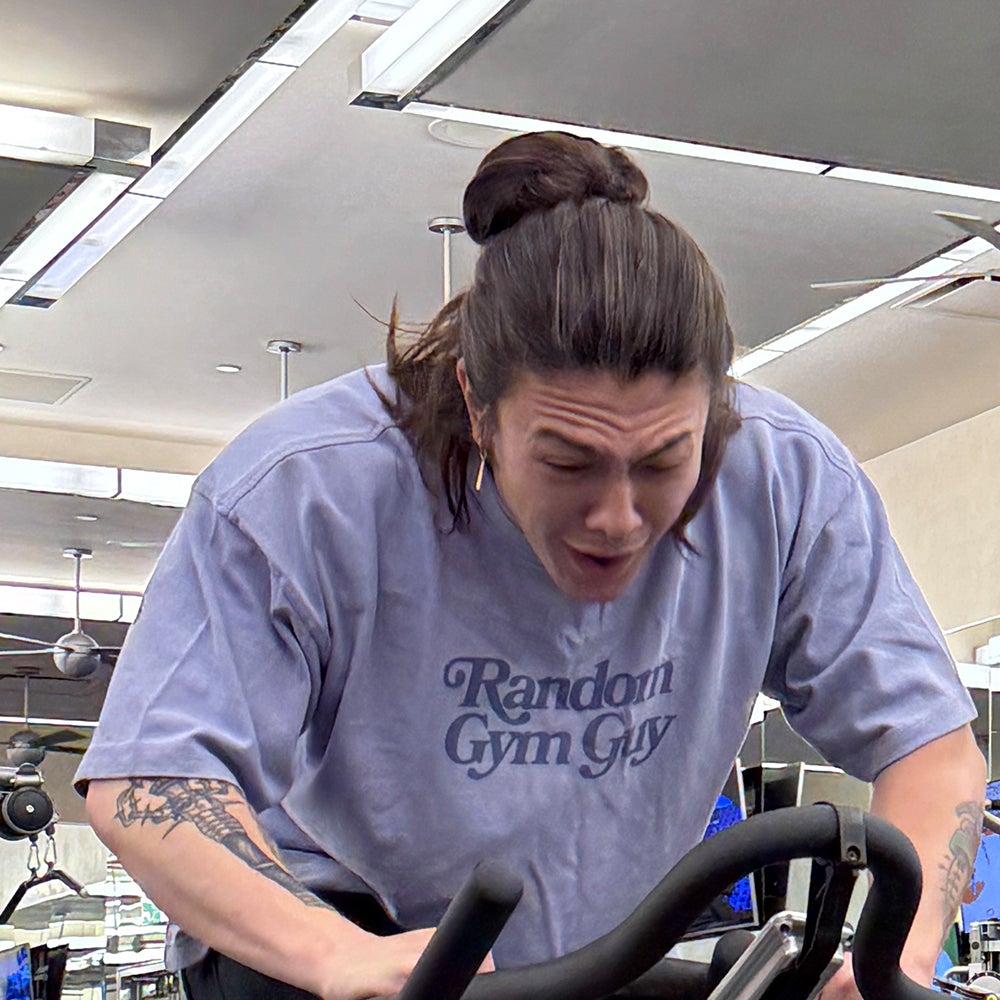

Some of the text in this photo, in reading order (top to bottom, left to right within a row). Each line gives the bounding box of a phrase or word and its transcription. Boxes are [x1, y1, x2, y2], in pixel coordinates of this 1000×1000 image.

[443, 656, 674, 726] Random
[444, 711, 677, 780] Gym Guy
